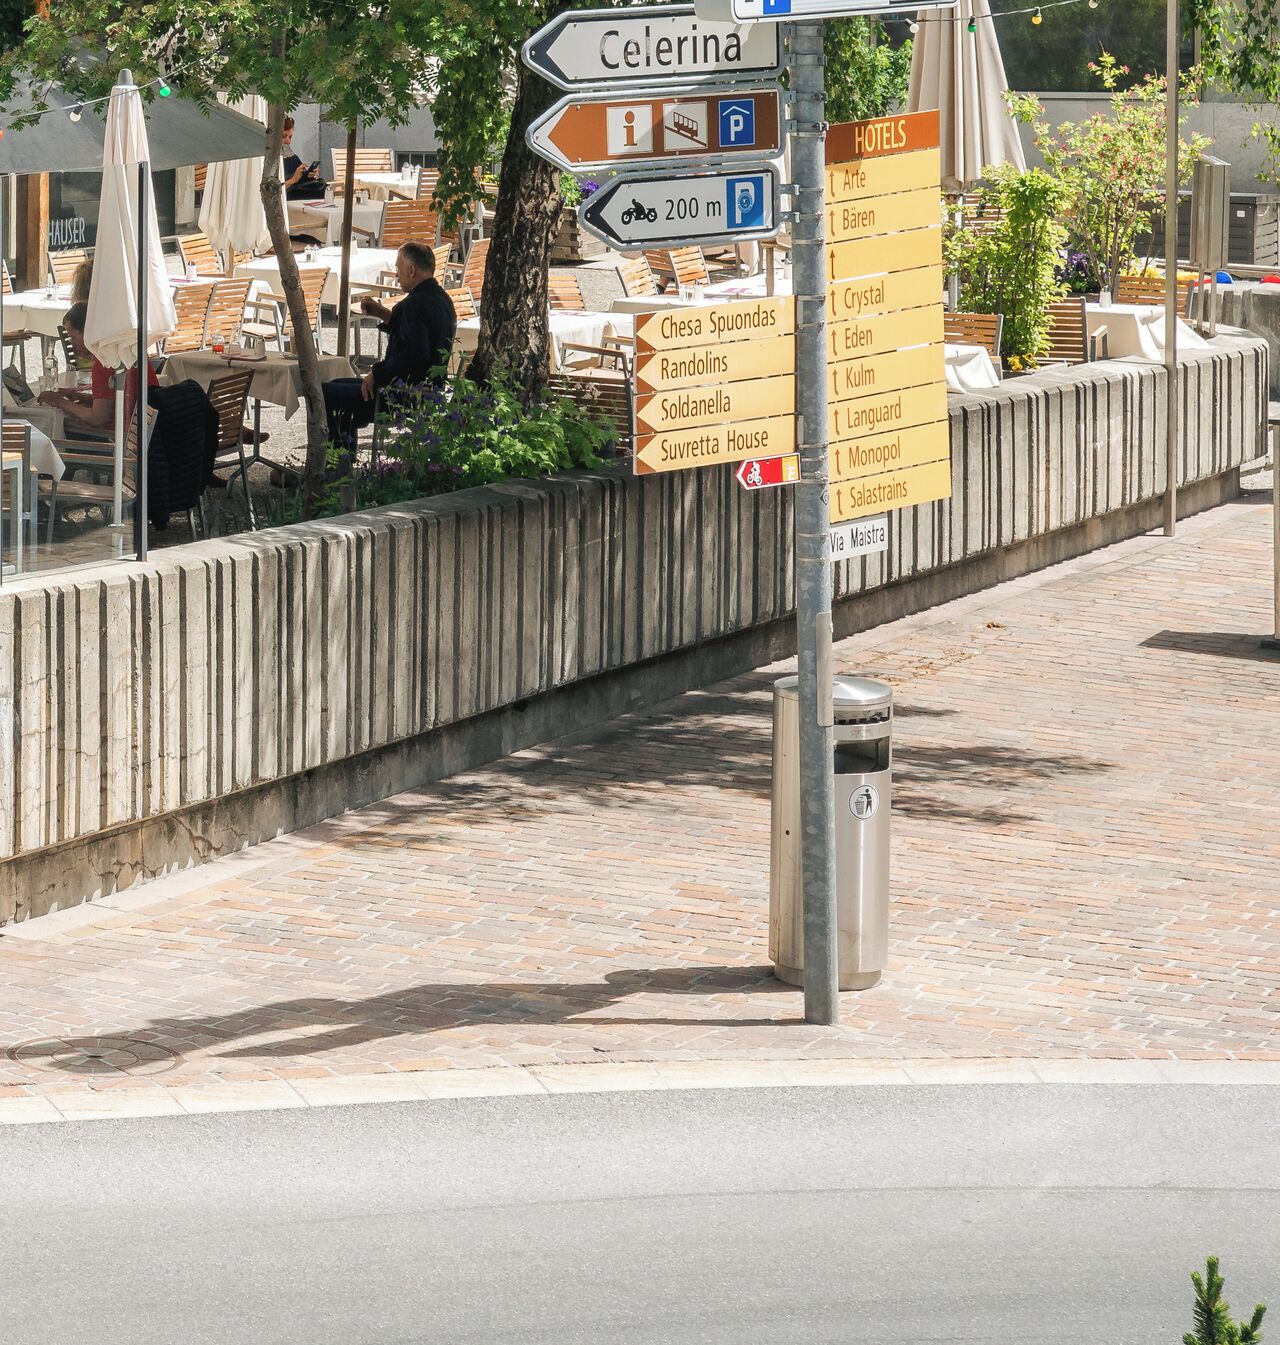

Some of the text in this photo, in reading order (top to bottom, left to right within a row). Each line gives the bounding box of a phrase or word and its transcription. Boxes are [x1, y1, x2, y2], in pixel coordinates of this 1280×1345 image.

[600, 24, 742, 71] Celerina
[855, 119, 907, 153] HOTELS
[843, 168, 866, 192] Arte
[665, 197, 699, 220] 200
[706, 199, 722, 217] m
[842, 207, 875, 231] Bären
[47, 217, 86, 246] HAUSER
[844, 280, 885, 313] Crystal
[661, 304, 776, 339] Chesa Spuondas
[845, 324, 873, 350] Eden
[661, 351, 728, 380] Randolins
[845, 363, 875, 388] Kulm
[661, 390, 731, 421] Soldanella
[847, 395, 902, 431] Languard
[661, 429, 769, 462] Suvretta House
[848, 436, 901, 470] Monopol
[850, 477, 908, 509] Salastrains
[830, 526, 885, 553] Via Maistra
